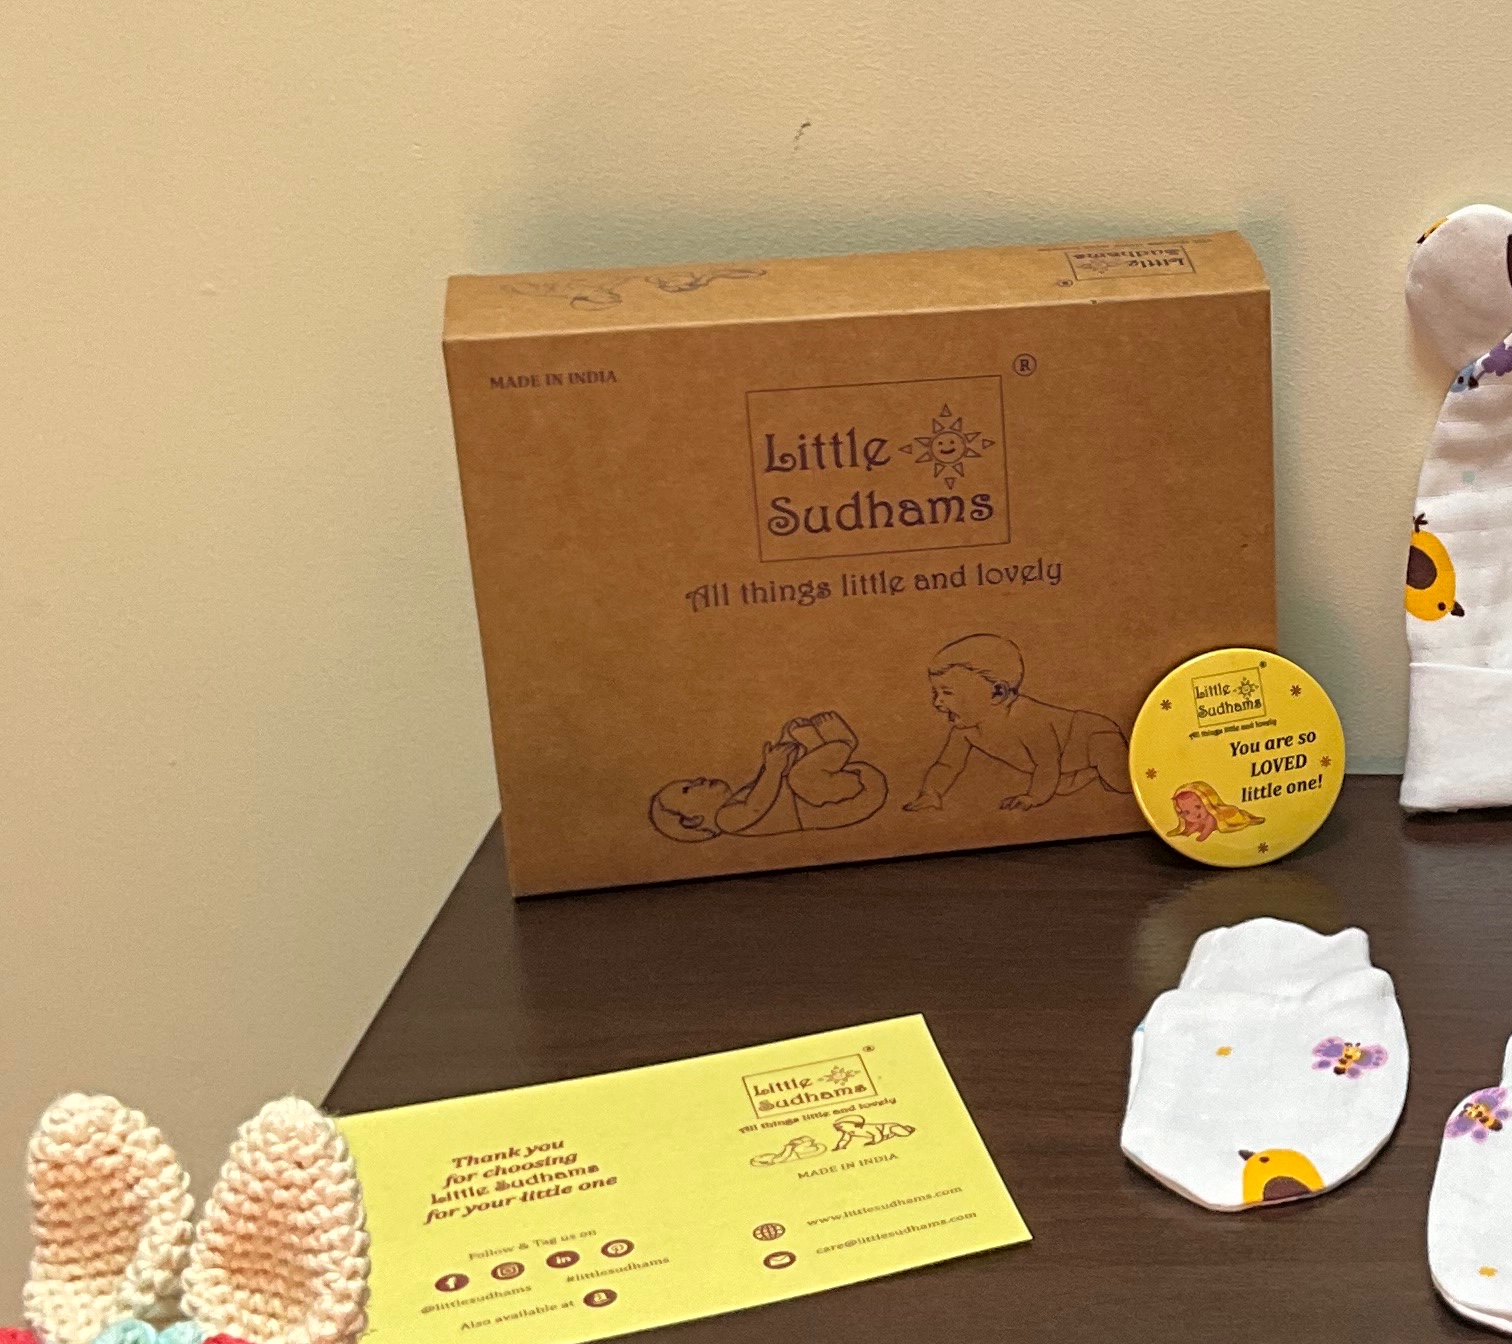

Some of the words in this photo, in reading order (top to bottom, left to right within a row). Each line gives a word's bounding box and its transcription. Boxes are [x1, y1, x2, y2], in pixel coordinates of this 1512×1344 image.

[490, 373, 541, 389] MADE
[545, 372, 563, 386] IN
[568, 370, 618, 385] INDIA
[763, 426, 891, 473] Little
[767, 490, 995, 537] Sudhams
[685, 581, 731, 613] All
[741, 578, 832, 606] things
[842, 570, 905, 597] little
[914, 563, 967, 592] and
[977, 557, 1063, 586] lovely
[1194, 683, 1231, 700] Little
[1197, 697, 1262, 719] Sudhams
[1230, 741, 1260, 757] You
[1265, 736, 1293, 751] are
[1298, 731, 1316, 746] so
[1250, 753, 1307, 778] LOVED
[1241, 781, 1282, 803] little
[1286, 774, 1323, 795] one!
[753, 1076, 813, 1097] Little
[758, 1082, 867, 1112] Sudhams
[802, 1109, 829, 1121] little
[832, 1103, 856, 1116] and
[859, 1095, 897, 1111] lovely
[451, 1146, 521, 1169] Thank
[524, 1139, 565, 1158] you
[797, 1165, 838, 1180] MADE
[841, 1161, 856, 1171] IN
[859, 1153, 899, 1167] INDIA
[431, 1184, 489, 1205] Little
[495, 1163, 599, 1192] Sudhams
[442, 1173, 480, 1190] for
[483, 1152, 578, 1179] choosing
[422, 1207, 460, 1226] for
[462, 1197, 517, 1218] your
[519, 1184, 573, 1203] little
[578, 1174, 618, 1192] one
[807, 1186, 963, 1226] www.littlesudhams.com
[469, 1245, 514, 1261] Follow
[518, 1242, 529, 1251] &
[532, 1237, 557, 1250] Tag
[561, 1233, 576, 1242] us
[580, 1228, 597, 1238] on
[816, 1211, 977, 1254] care@littlesudhams.com
[566, 1257, 670, 1283] #littlesudhams
[420, 1285, 532, 1314] @littlesudhams
[460, 1319, 491, 1332] Also
[495, 1302, 557, 1324] available
[561, 1299, 574, 1309] at
